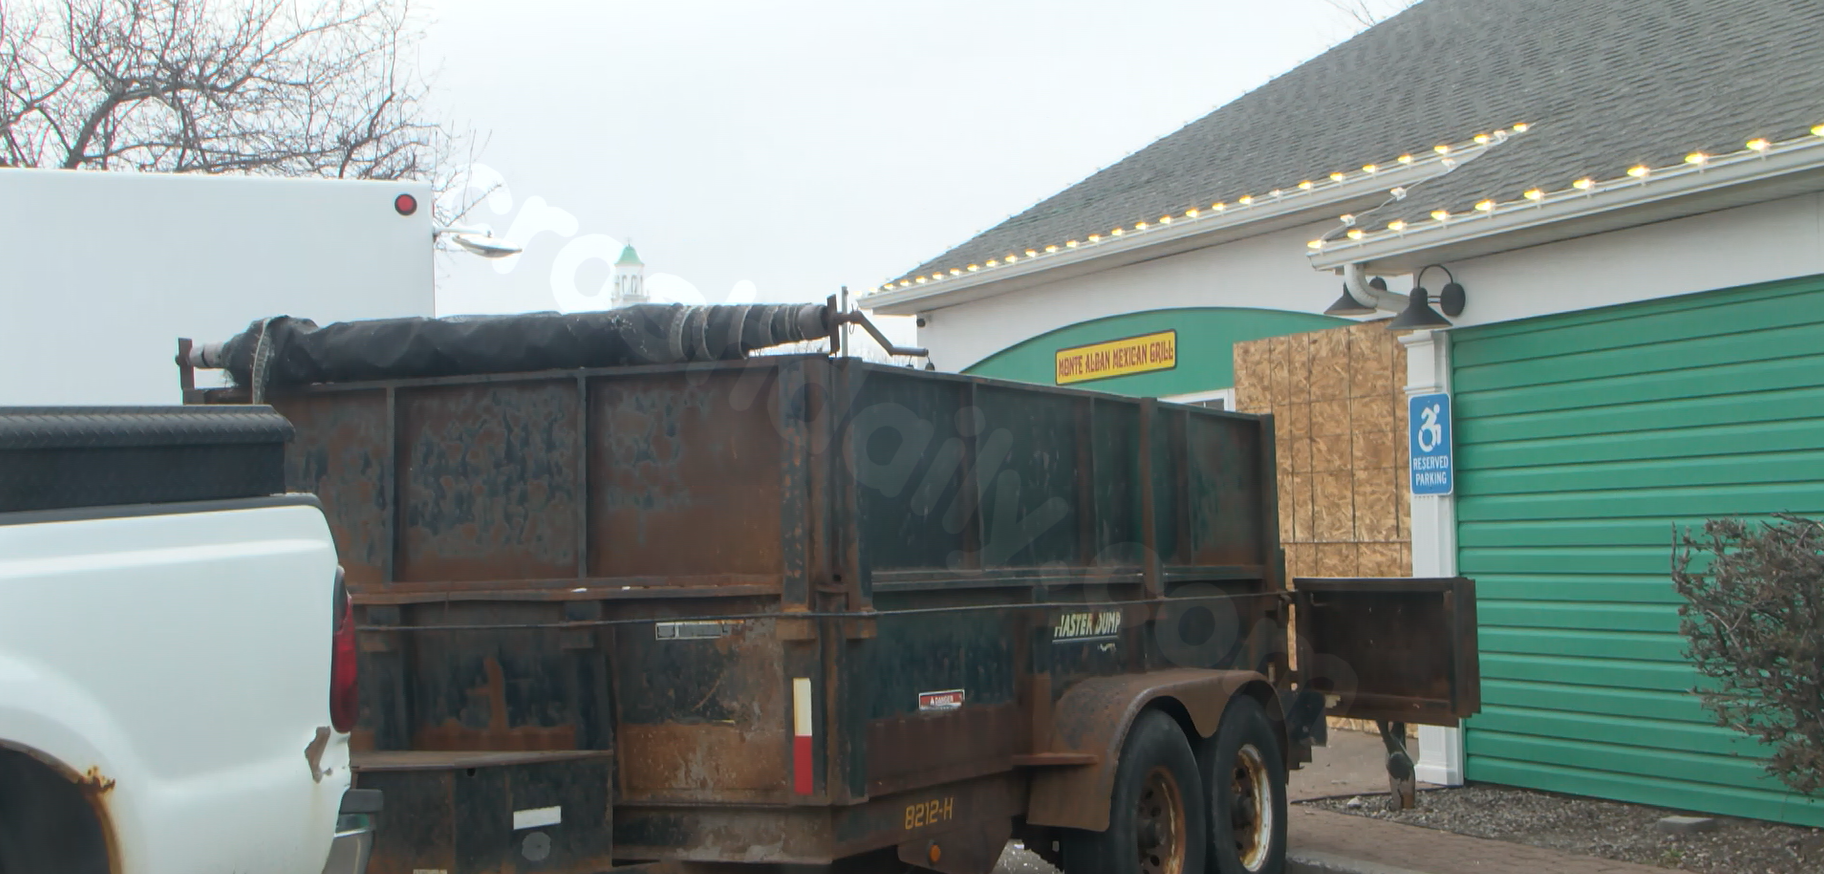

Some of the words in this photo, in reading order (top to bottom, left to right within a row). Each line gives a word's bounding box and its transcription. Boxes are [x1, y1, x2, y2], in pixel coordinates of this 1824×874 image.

[1058, 355, 1083, 378] MONTE
[1085, 351, 1110, 374] ALBAN
[1112, 343, 1148, 370] MEXICAN
[1149, 340, 1174, 364] GRILL
[1412, 455, 1449, 471] RESERVED
[1415, 471, 1447, 487] PARKING
[1094, 610, 1121, 636] DUMP
[904, 796, 954, 831] 8212-H
